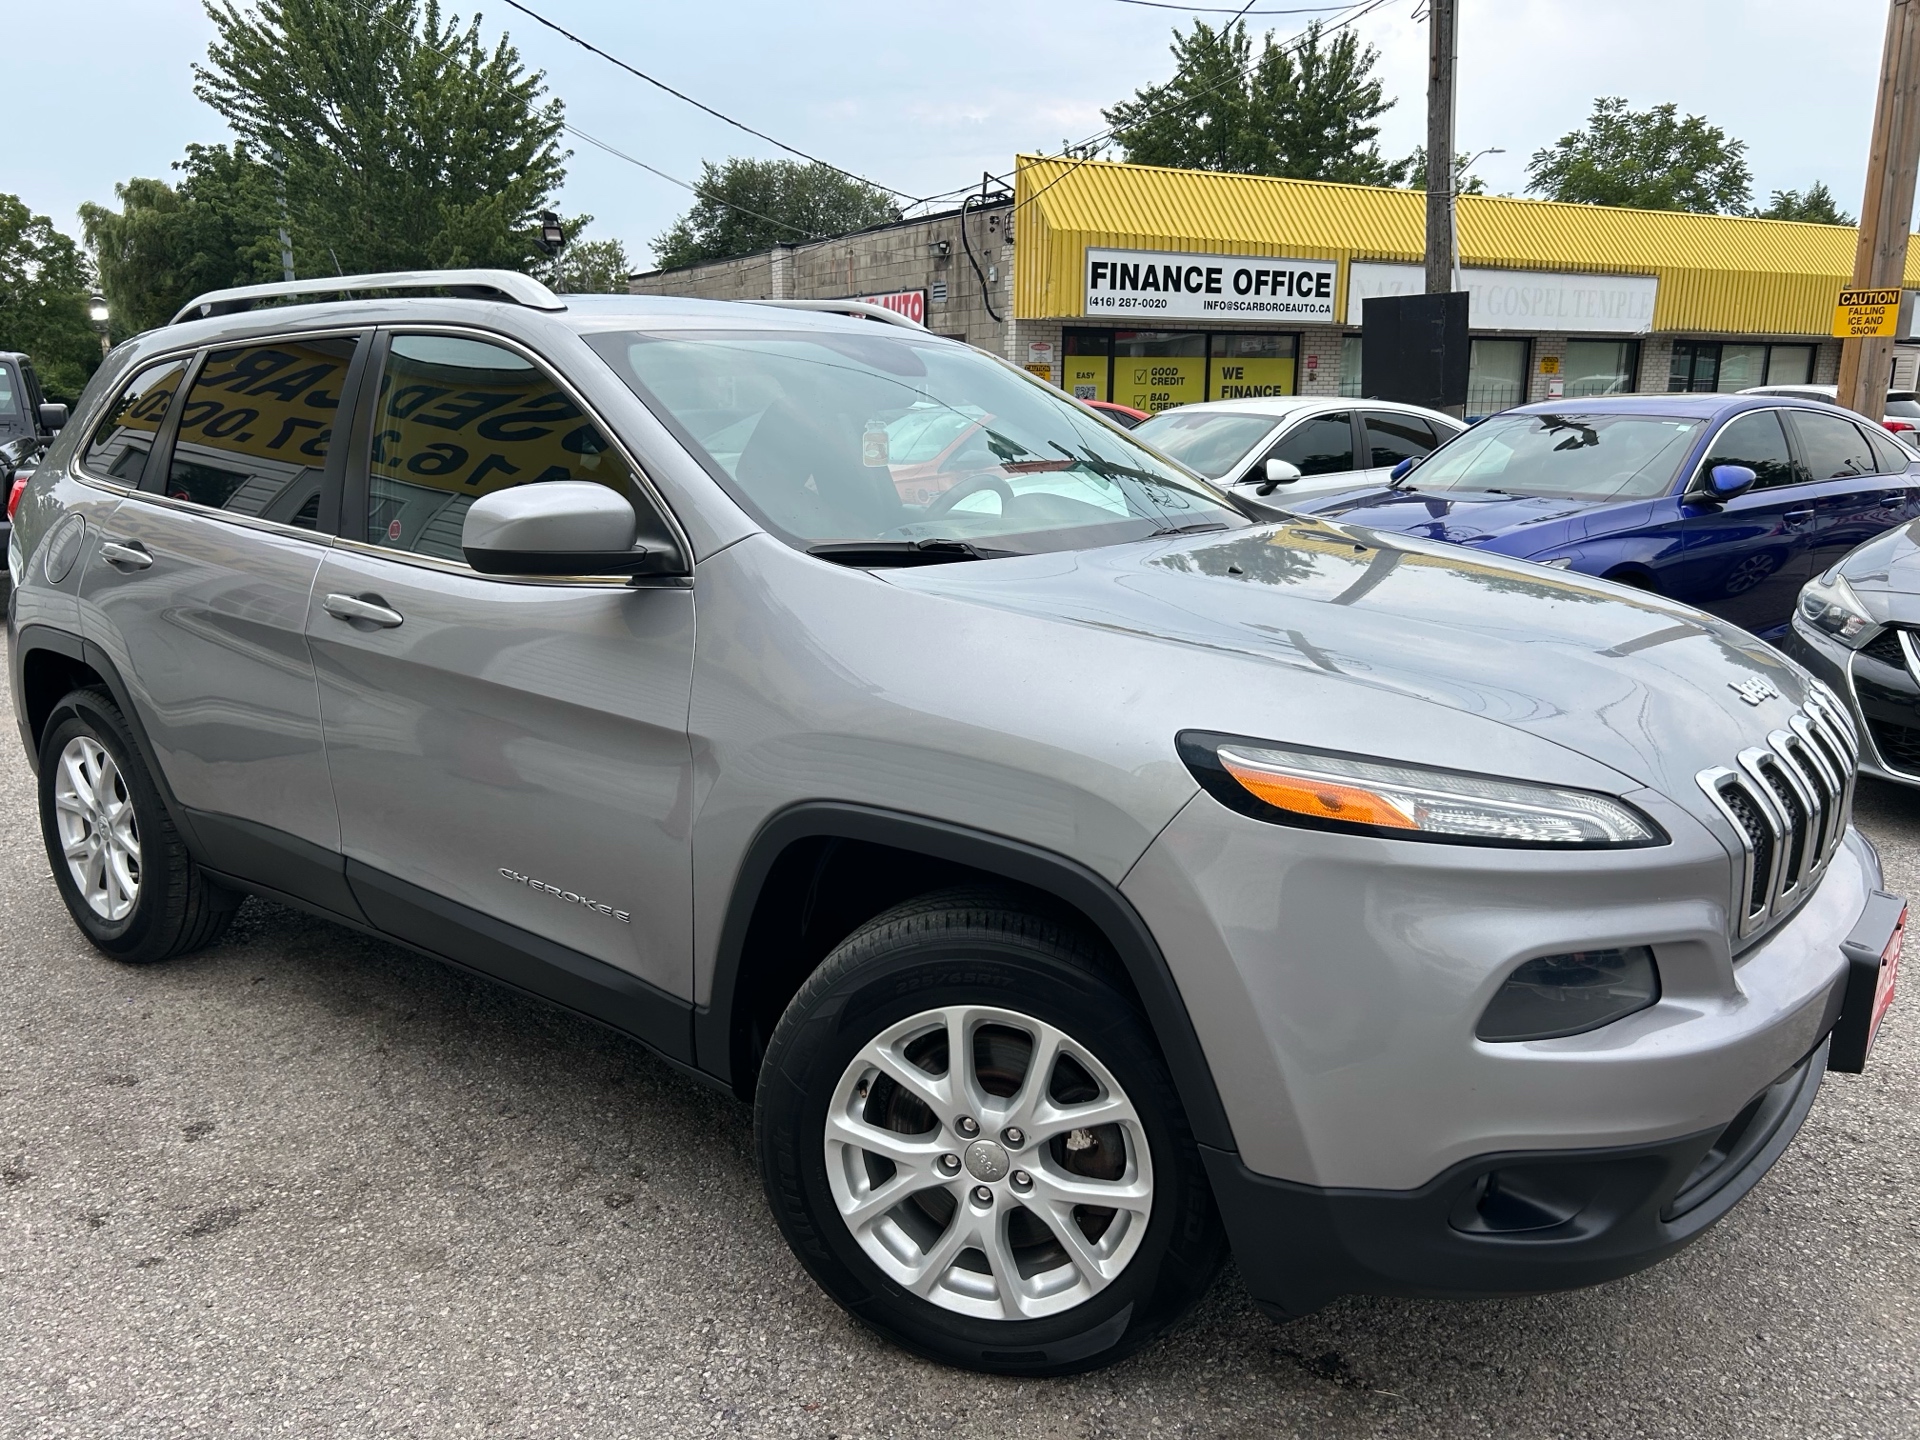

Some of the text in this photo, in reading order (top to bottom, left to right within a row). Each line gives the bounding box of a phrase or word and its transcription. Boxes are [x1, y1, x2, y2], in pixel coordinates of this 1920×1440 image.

[1091, 262, 1331, 298] FINANCE OFFICE
[1089, 296, 1167, 309] (416) 287-0020
[1488, 285, 1570, 318] GOSPEL
[1573, 289, 1651, 320] TEMPLE
[1841, 292, 1897, 305] CAUTION
[1203, 300, 1331, 314] INFO@SCARBOROEAUTO.CA
[1848, 307, 1885, 316] FALLING
[1848, 317, 1883, 325] ICE AND
[1850, 326, 1878, 335] SNOW
[1151, 367, 1178, 376] GOOD
[1222, 367, 1244, 380] WE
[1151, 377, 1185, 386] CREDIT
[1150, 393, 1170, 401] BAD
[1221, 385, 1282, 399] FINANCE
[498, 867, 631, 924] CHEROKEE
